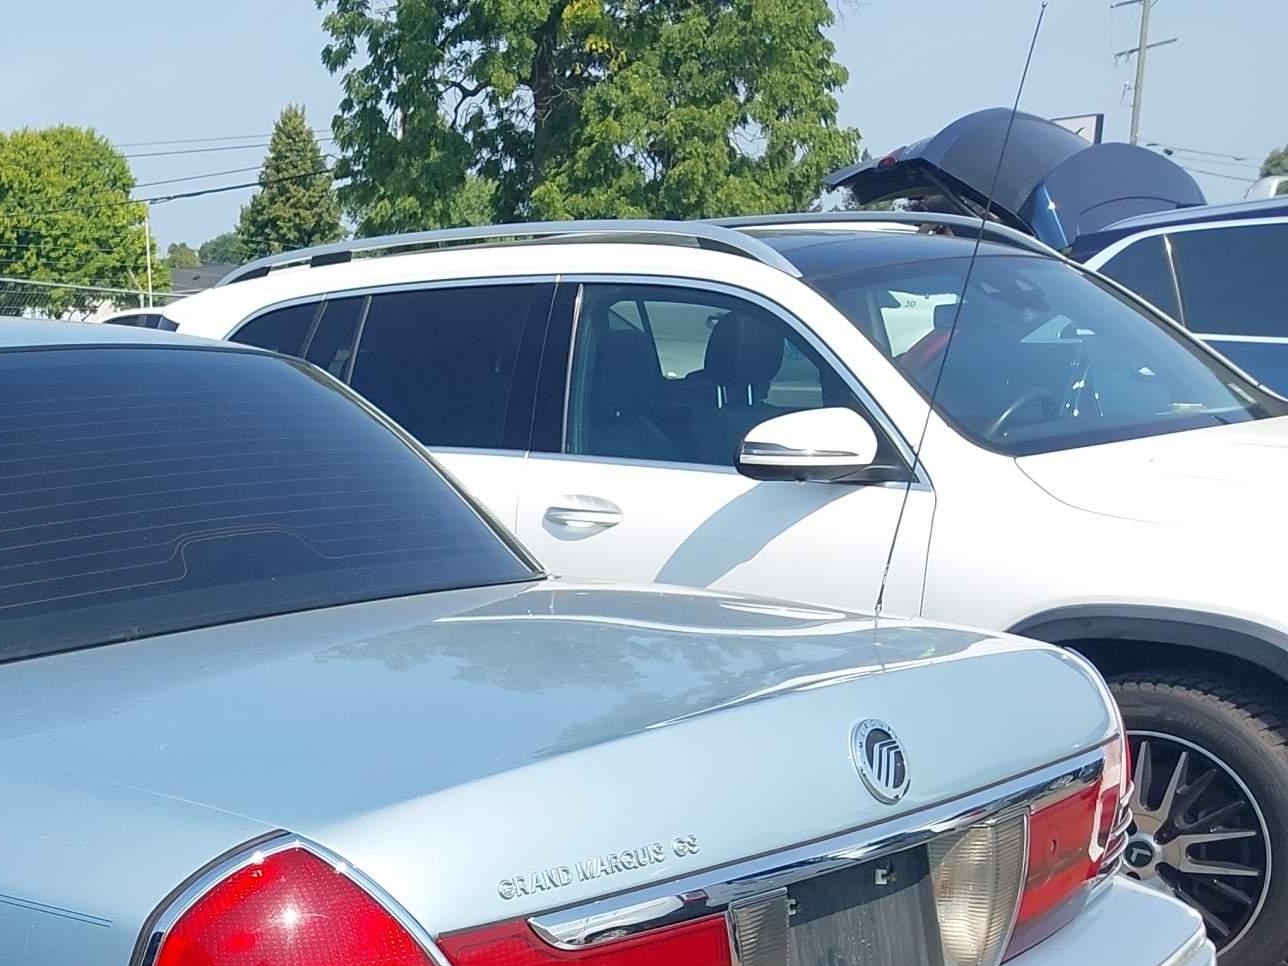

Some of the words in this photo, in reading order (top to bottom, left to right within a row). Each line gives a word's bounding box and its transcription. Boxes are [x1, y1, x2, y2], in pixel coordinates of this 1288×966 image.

[497, 865, 573, 901] GRAND
[576, 843, 666, 881] MARQUIS
[671, 834, 701, 858] GS
